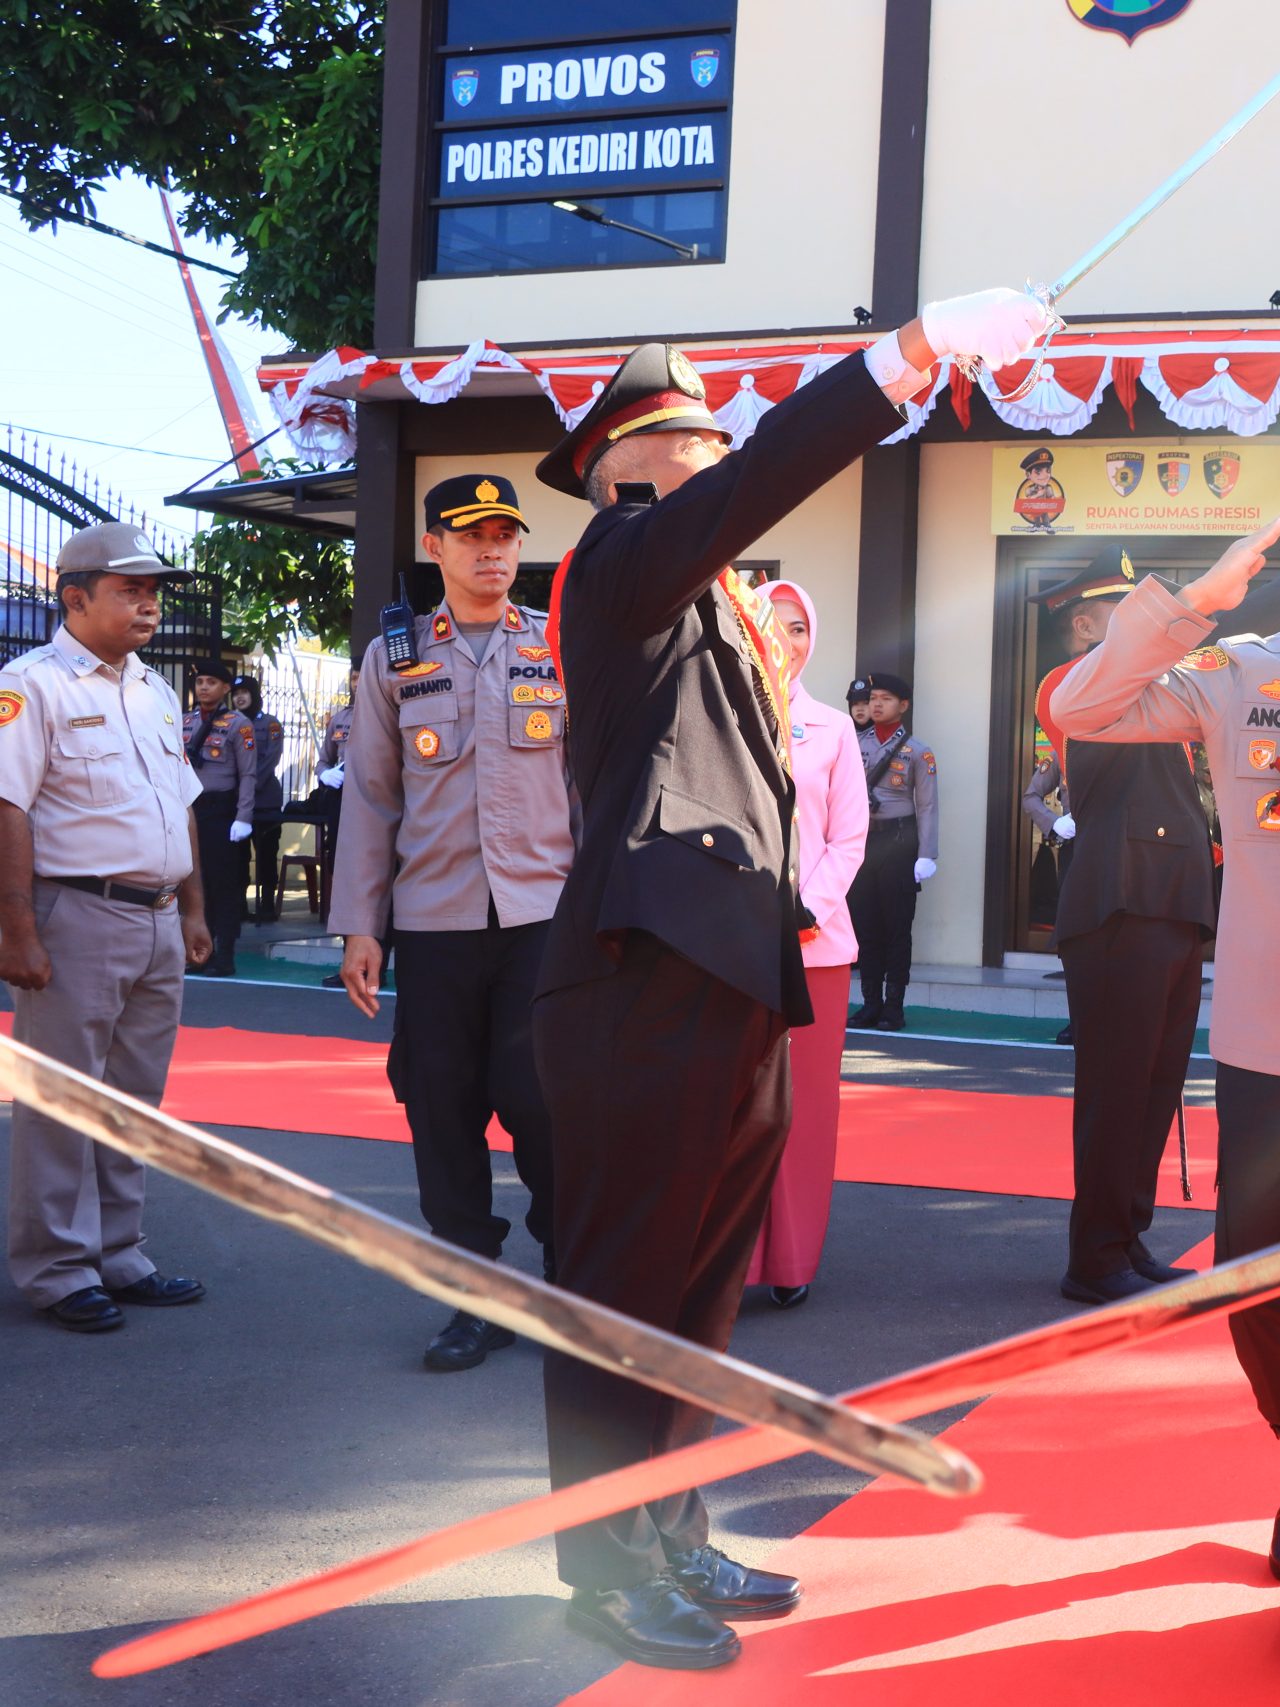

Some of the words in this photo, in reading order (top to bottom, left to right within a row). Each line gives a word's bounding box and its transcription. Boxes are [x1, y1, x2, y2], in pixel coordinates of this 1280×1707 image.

[500, 52, 666, 105] PROVOS
[447, 137, 544, 183] POLRES
[547, 131, 637, 176] KEDIRI
[643, 125, 714, 170] KOTA
[1086, 507, 1140, 519] RUANG
[1143, 507, 1200, 519] DUMAS
[1203, 507, 1261, 519] PRESISI
[1085, 523, 1118, 531] SENTRA
[1119, 523, 1169, 531] PELAYANAN
[1169, 523, 1201, 531] DUMAS
[1202, 523, 1261, 532] TERINTEGRASI
[509, 666, 558, 681] POLR
